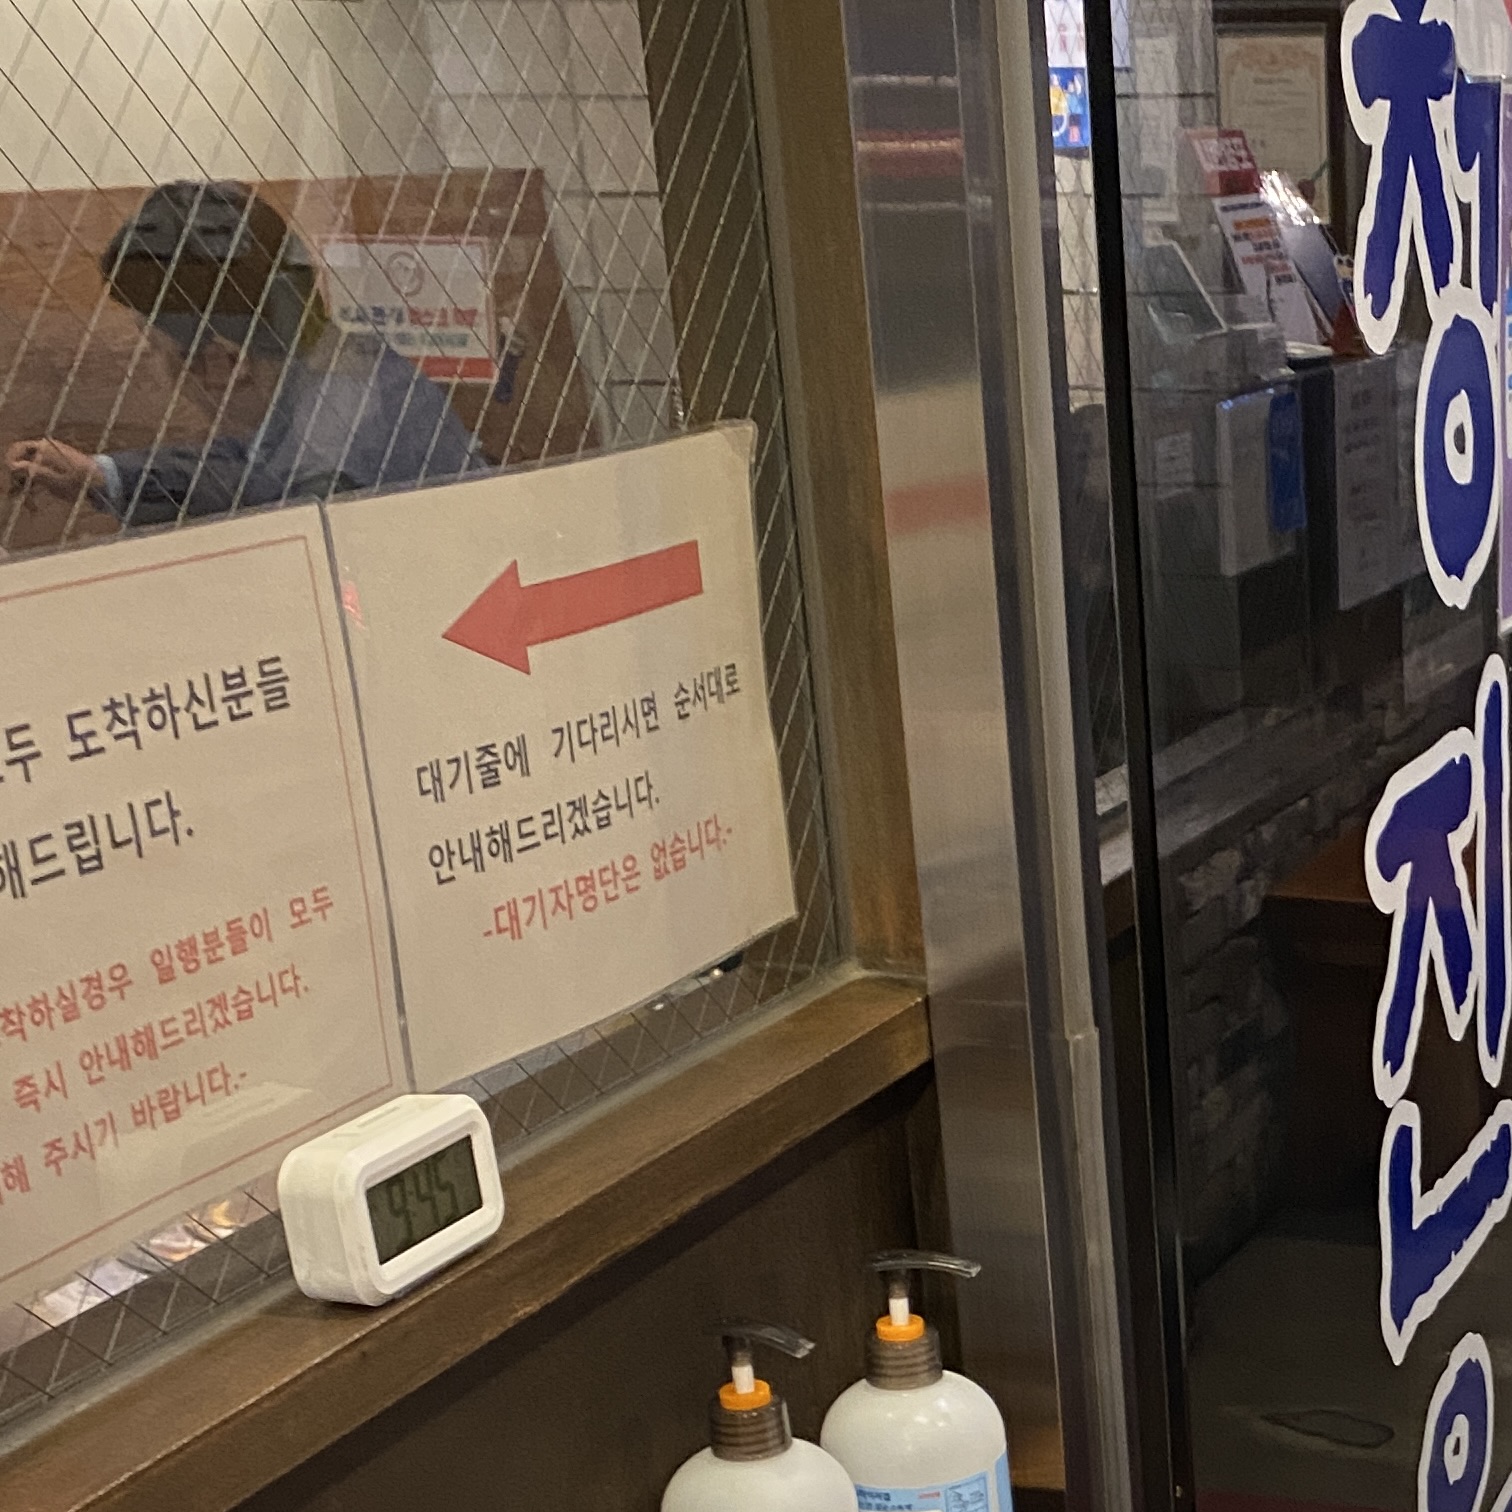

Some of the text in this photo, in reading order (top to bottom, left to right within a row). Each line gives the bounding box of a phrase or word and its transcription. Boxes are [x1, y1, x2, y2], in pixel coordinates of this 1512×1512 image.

[0, 655, 291, 783] 두 도착하신분들
[416, 662, 741, 803] 대기줄에 기다리시면 순서대로
[428, 770, 660, 886] 안내해드리겠습니다.
[151, 907, 273, 985] 일행분들이
[288, 886, 334, 929] 모두
[483, 854, 641, 941] -대기자명단은
[14, 963, 310, 1112] 즉시 안내해드리겠습니다.
[43, 1113, 119, 1177] 주시기
